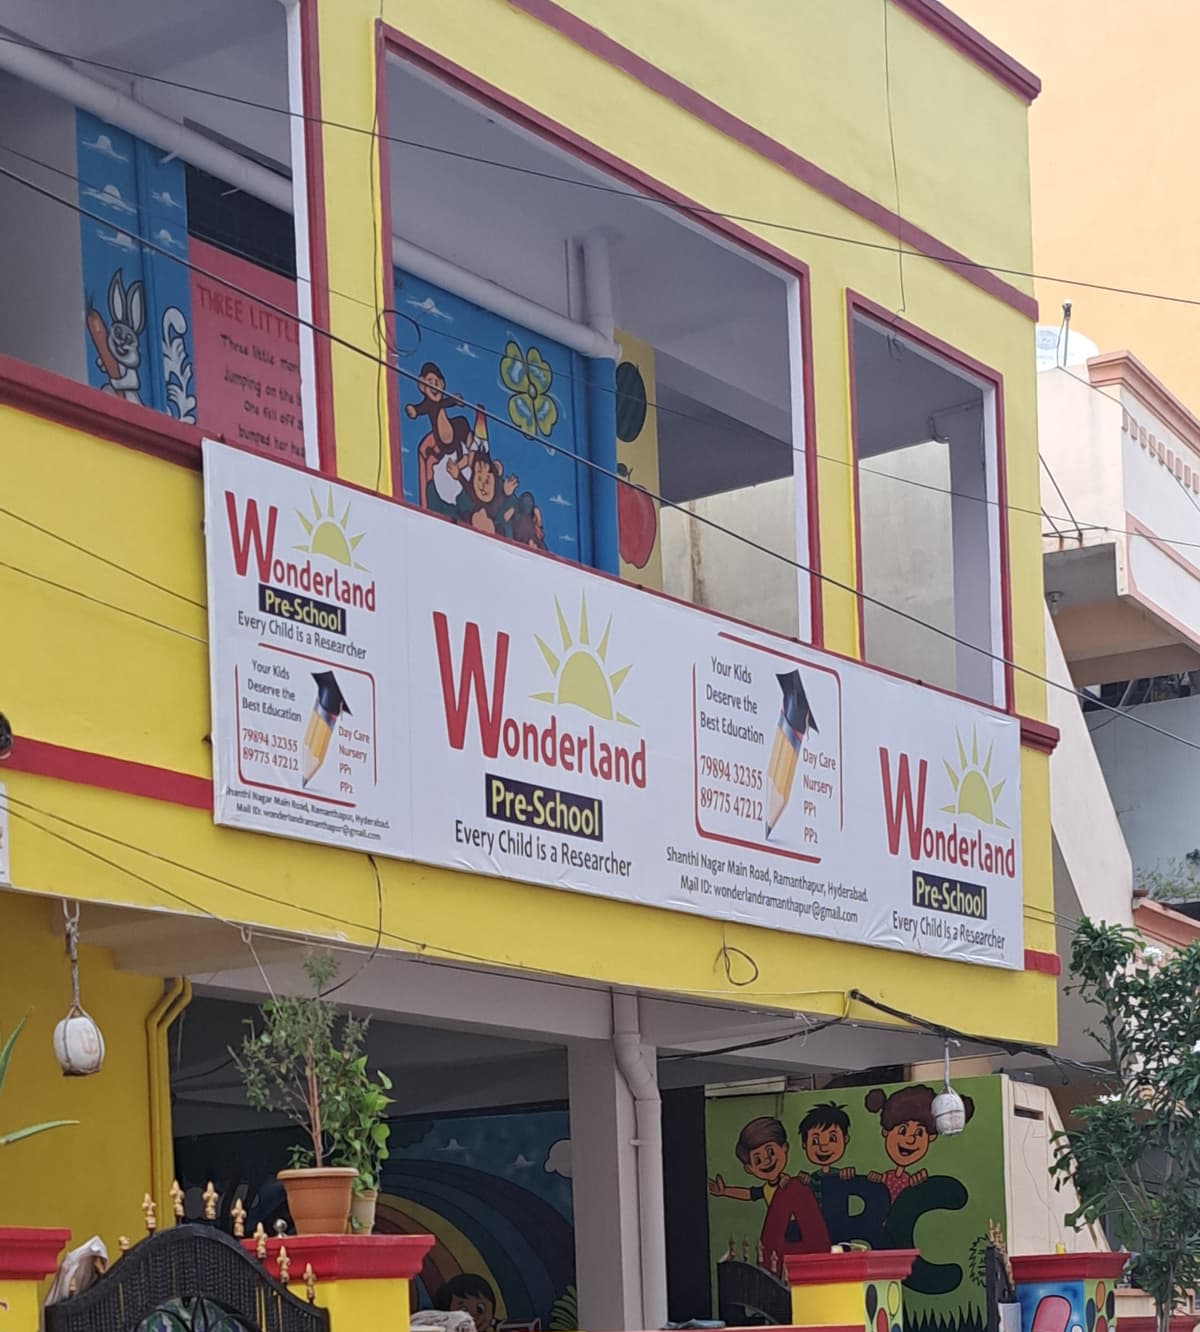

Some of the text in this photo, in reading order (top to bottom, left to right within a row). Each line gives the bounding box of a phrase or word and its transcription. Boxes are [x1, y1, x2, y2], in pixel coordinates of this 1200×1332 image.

[198, 285, 298, 344] THREE LITTL
[265, 385, 276, 397] on
[225, 491, 375, 611] Wonderland
[265, 590, 341, 632] Pre-School
[238, 611, 367, 659] Every Child is a Researcher
[252, 659, 290, 680] Your Kids
[711, 656, 752, 684] Your Kids
[248, 679, 295, 700] Deserve the
[433, 611, 646, 789] Wonderland
[706, 684, 757, 714] Deserve the
[242, 697, 302, 722] Best Education
[243, 728, 298, 752] 79894 32355
[338, 726, 370, 744] Day Care
[700, 712, 764, 744] Best Education
[243, 747, 298, 771] 89775 47212
[338, 745, 367, 765] Nursery
[339, 763, 351, 775] PP1
[803, 748, 836, 770] Day Care
[700, 755, 763, 790] 79894 32355
[803, 775, 833, 799] Nursery
[237, 803, 250, 813] Mail
[491, 780, 599, 836] Pre-School
[700, 787, 763, 821] 89775 47212
[804, 800, 816, 817] PP1
[879, 747, 1015, 879] Wonderland
[456, 820, 632, 877] Every Child is a Researcher
[804, 827, 818, 844] PP2
[667, 846, 868, 903] Shanthi Nagar Main Road, Ramanthapur, Hyderabad.
[681, 875, 858, 923] Mail ID: wonderlandramanthapur@gmail.com
[915, 877, 985, 917] Pre-School
[893, 911, 918, 937] Every
[920, 918, 942, 938] Child
[953, 927, 959, 940] a
[960, 925, 1006, 949] Researcher
[761, 1175, 969, 1294] ABC
